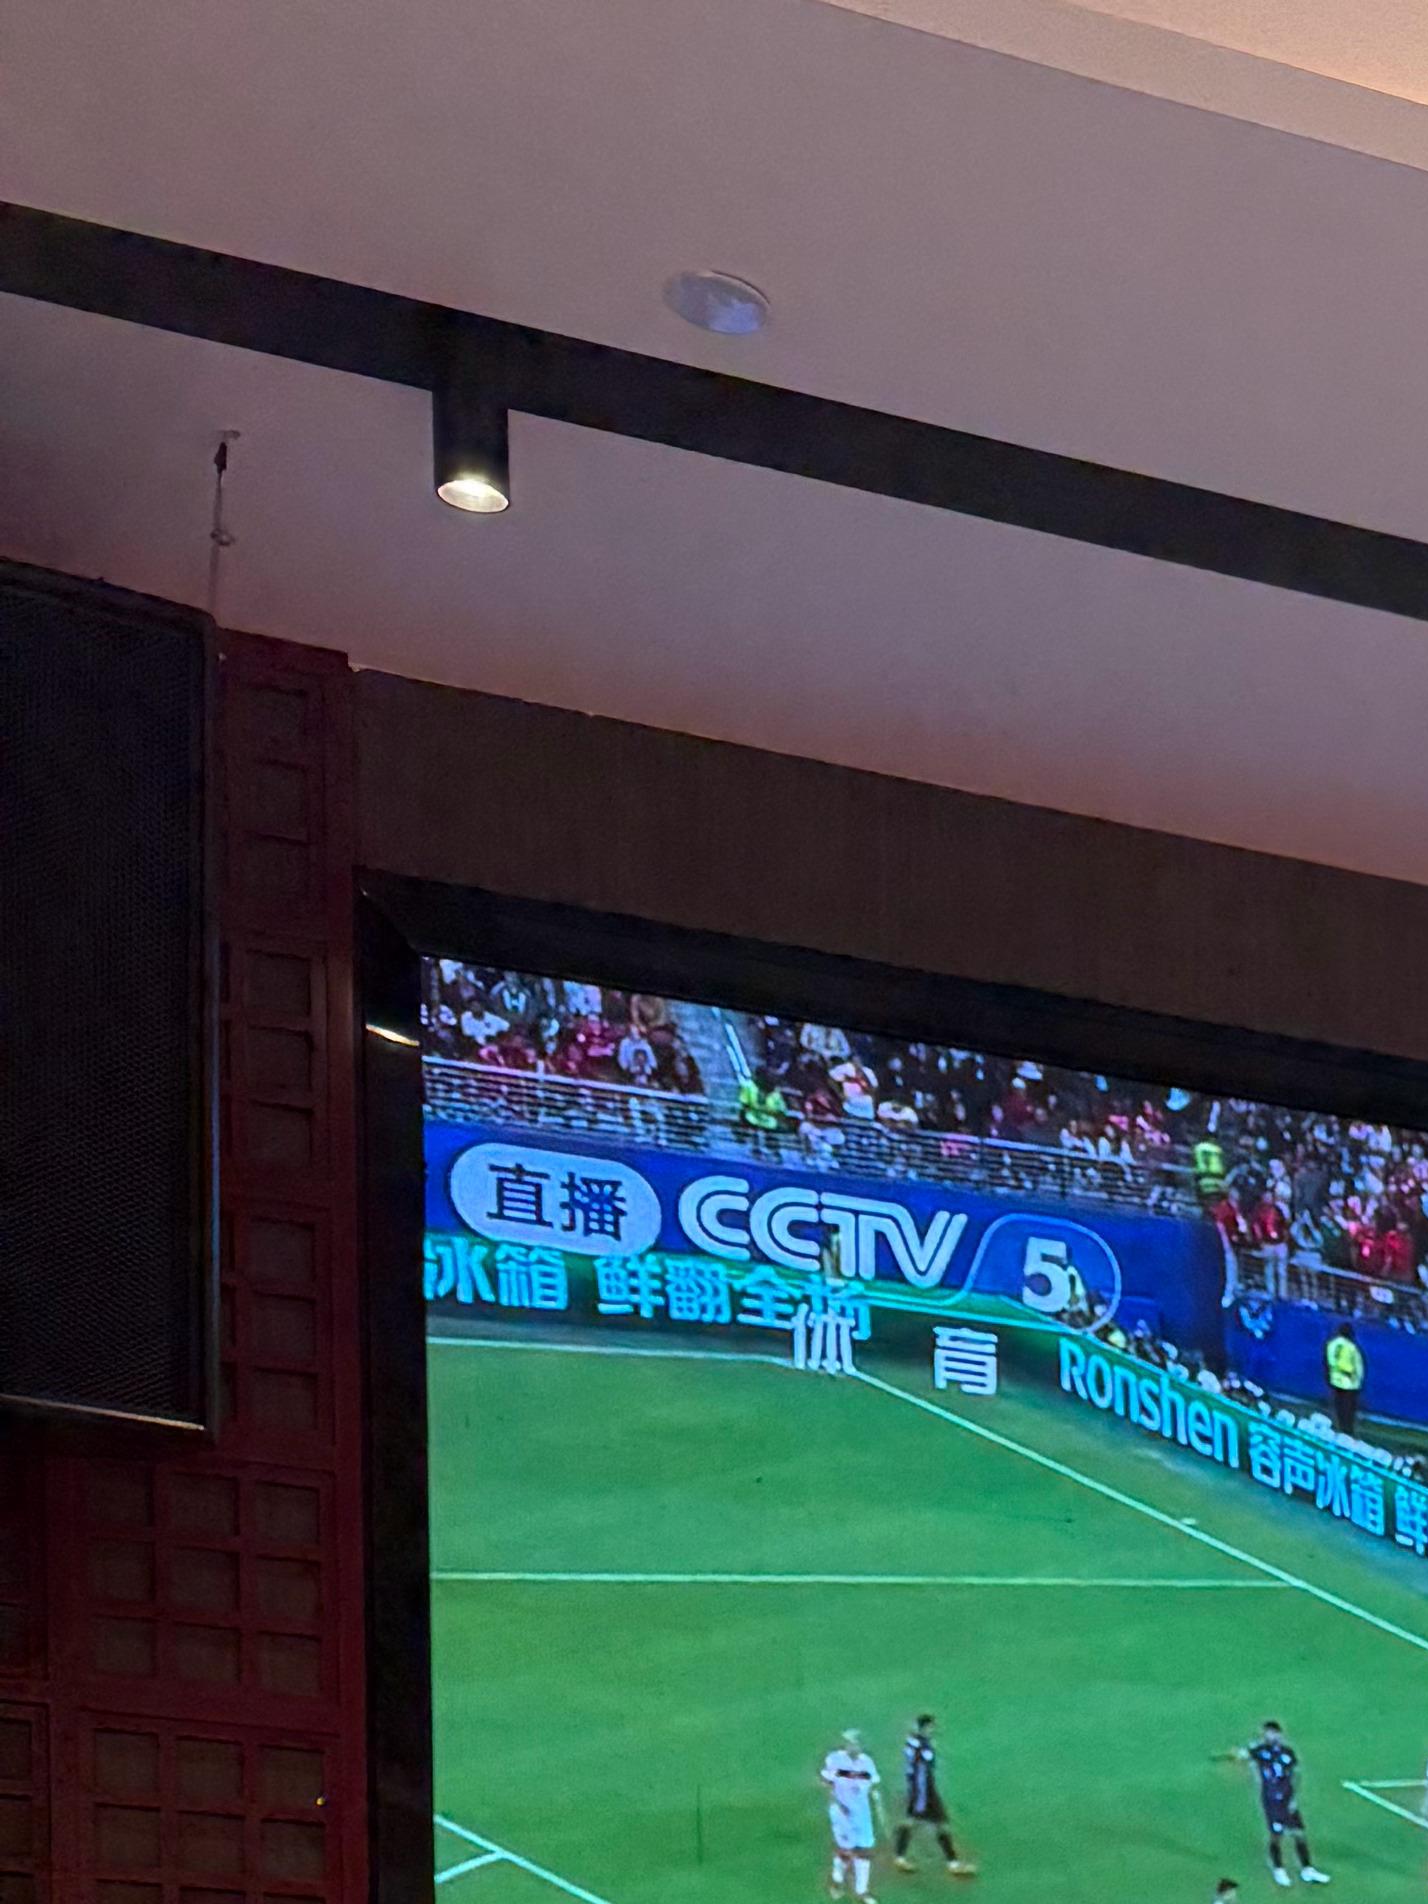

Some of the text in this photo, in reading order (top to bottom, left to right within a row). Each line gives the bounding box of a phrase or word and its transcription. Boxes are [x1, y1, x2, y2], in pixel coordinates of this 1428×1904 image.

[486, 1162, 627, 1241] 直播
[678, 1175, 1077, 1313] CCTV 5
[1059, 1337, 1239, 1468] Ronshen
[1247, 1420, 1386, 1536] 容声冰箱
